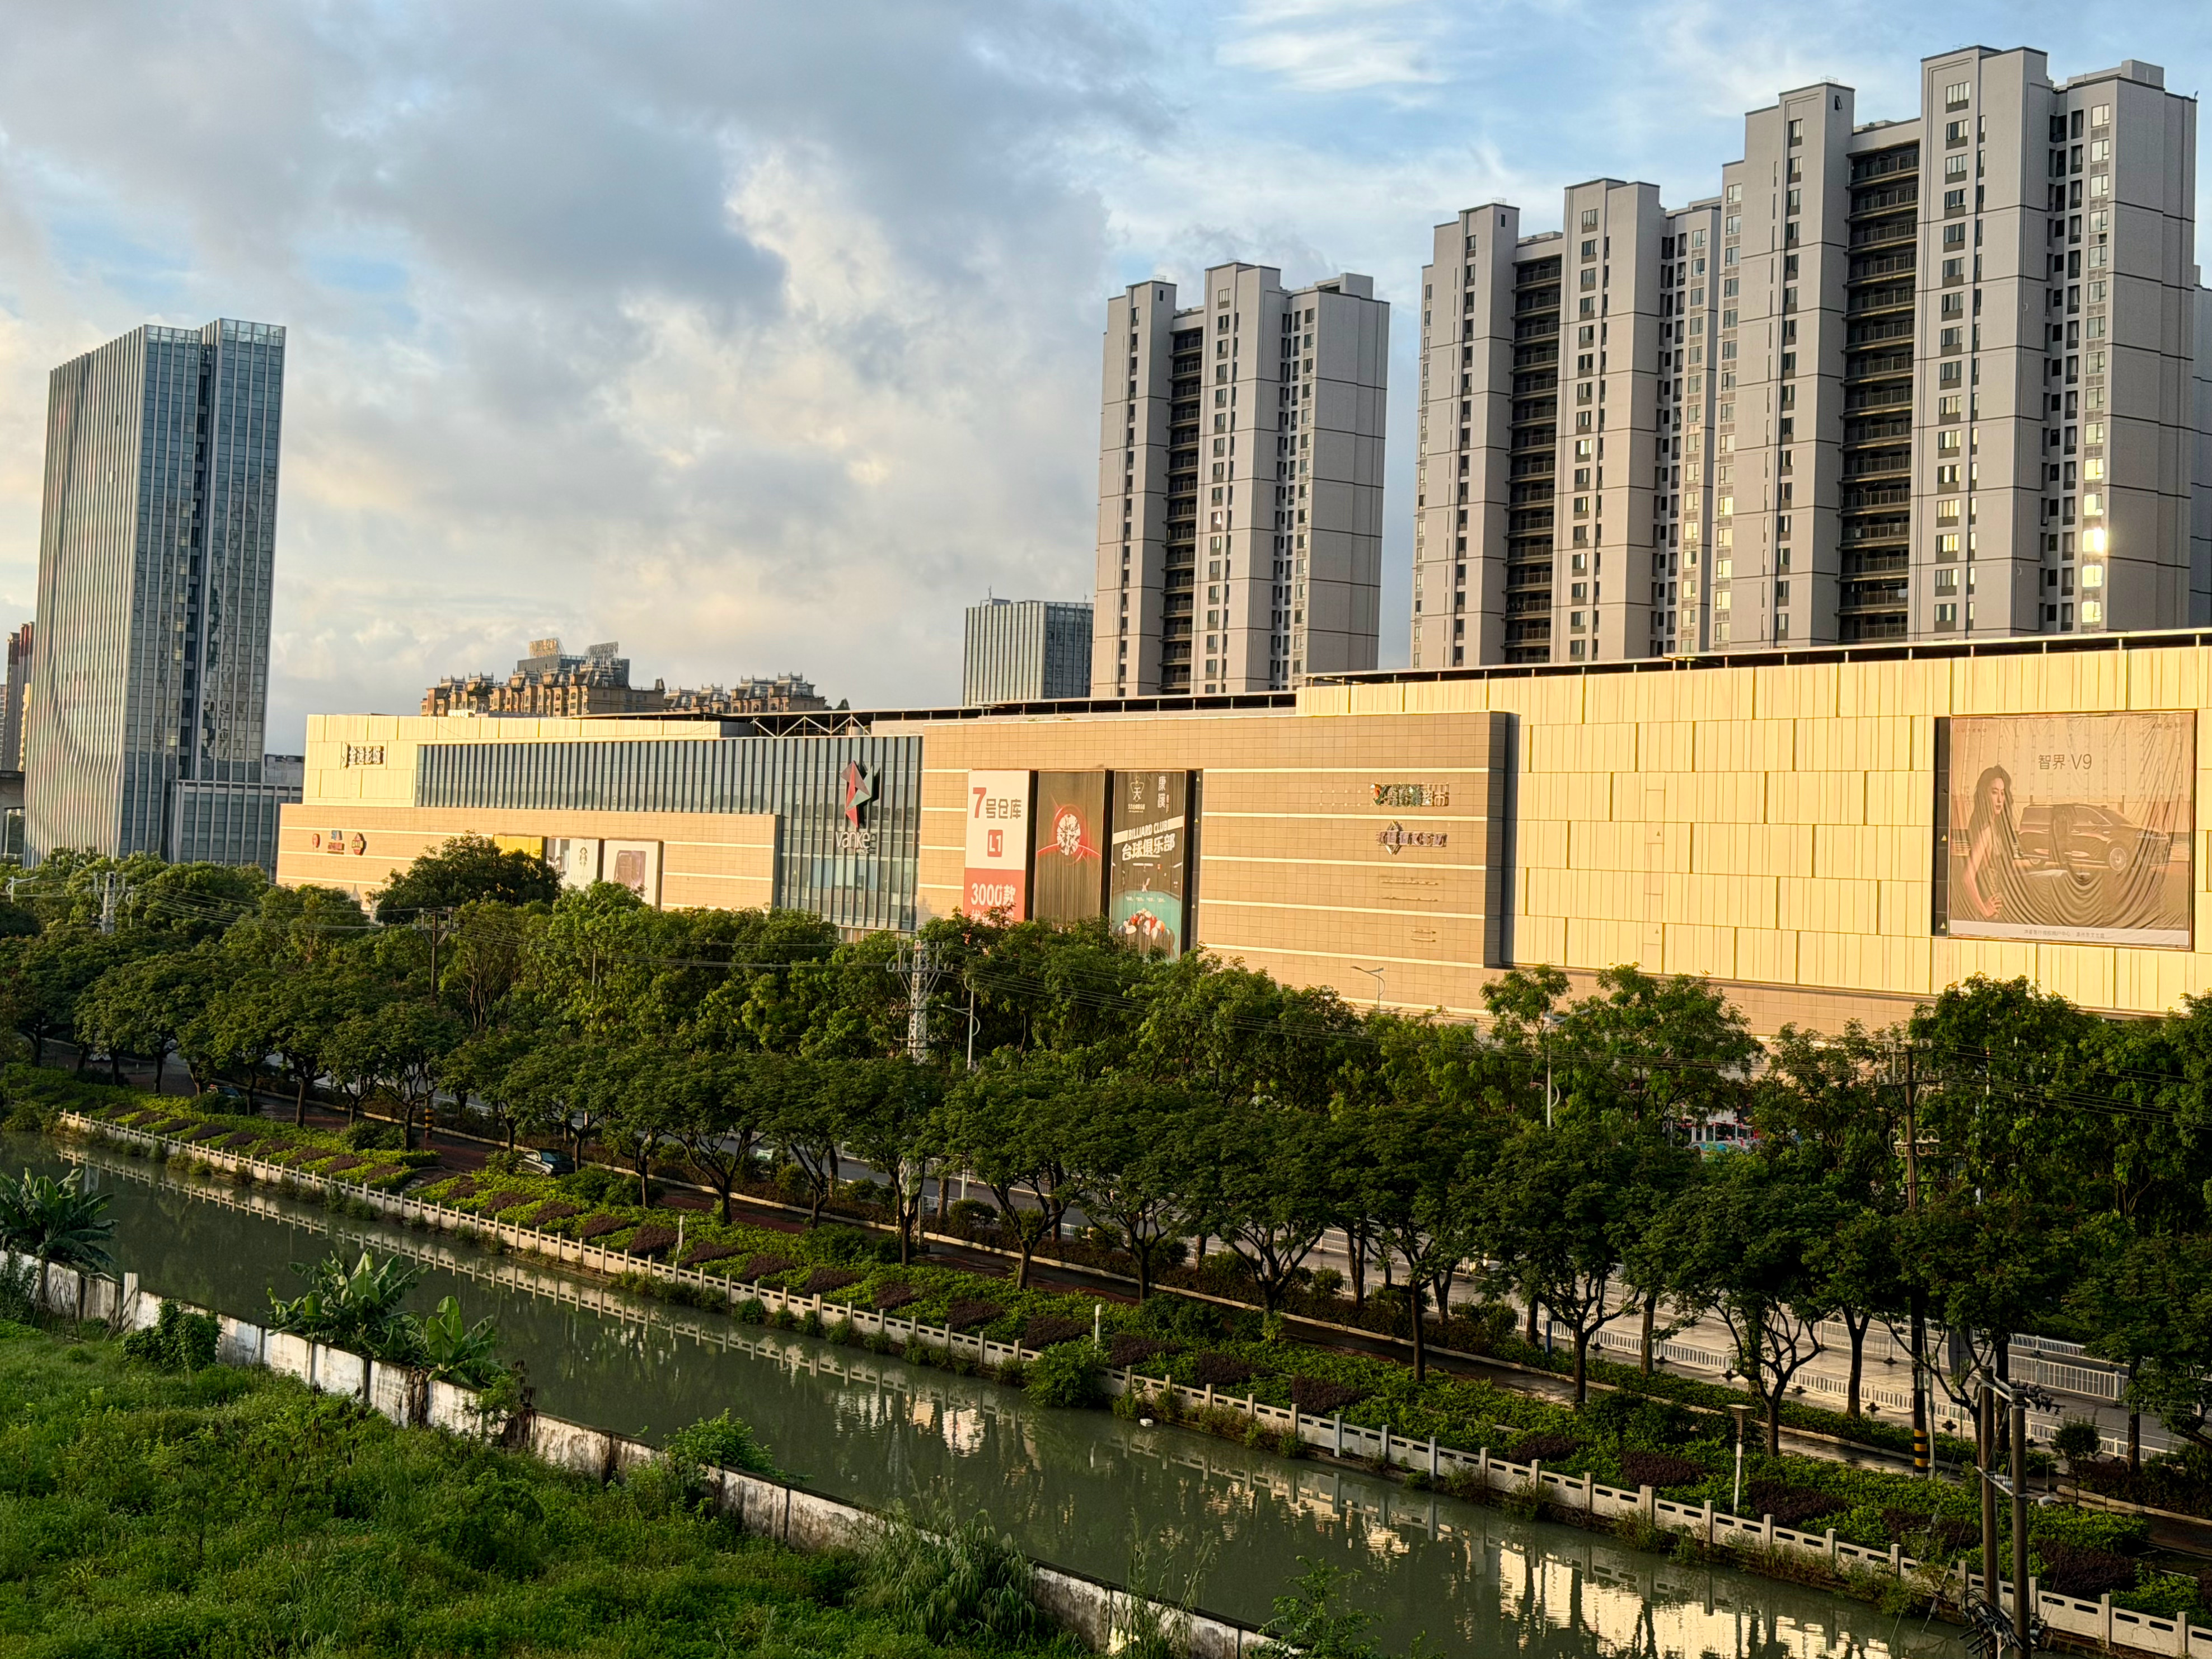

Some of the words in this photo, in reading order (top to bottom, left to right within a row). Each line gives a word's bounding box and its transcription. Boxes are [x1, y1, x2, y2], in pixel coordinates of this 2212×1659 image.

[2038, 754, 2065, 770] 智界
[2071, 753, 2092, 770] V9
[973, 787, 1021, 819] 7号仓库
[1128, 824, 1152, 841] BILLIARD
[1154, 820, 1168, 834] CLUB
[989, 835, 1001, 852] L1
[1122, 833, 1175, 861] 台球俱乐部
